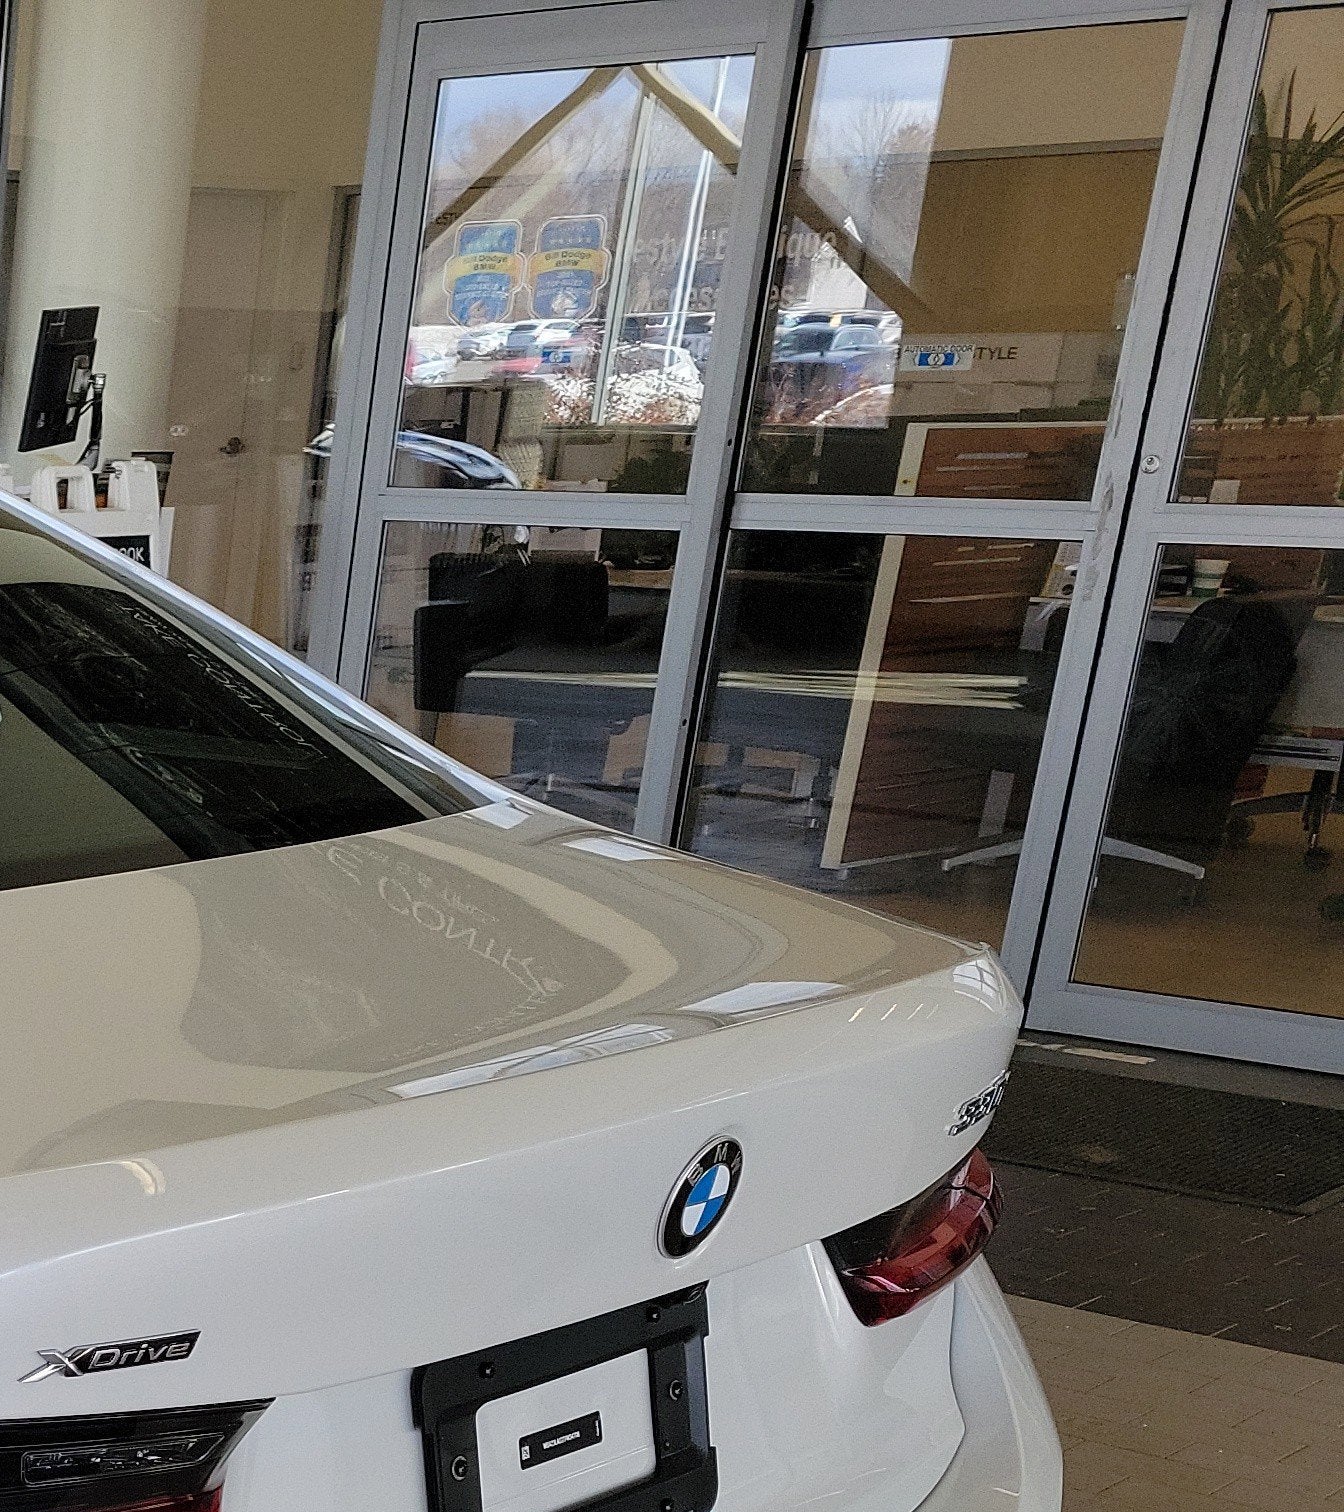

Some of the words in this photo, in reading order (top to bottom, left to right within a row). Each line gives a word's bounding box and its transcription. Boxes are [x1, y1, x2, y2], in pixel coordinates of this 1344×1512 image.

[478, 254, 508, 264] Dodge
[561, 250, 592, 260] Dodge
[903, 344, 951, 354] AUTOMATIC
[951, 344, 974, 353] DOOR
